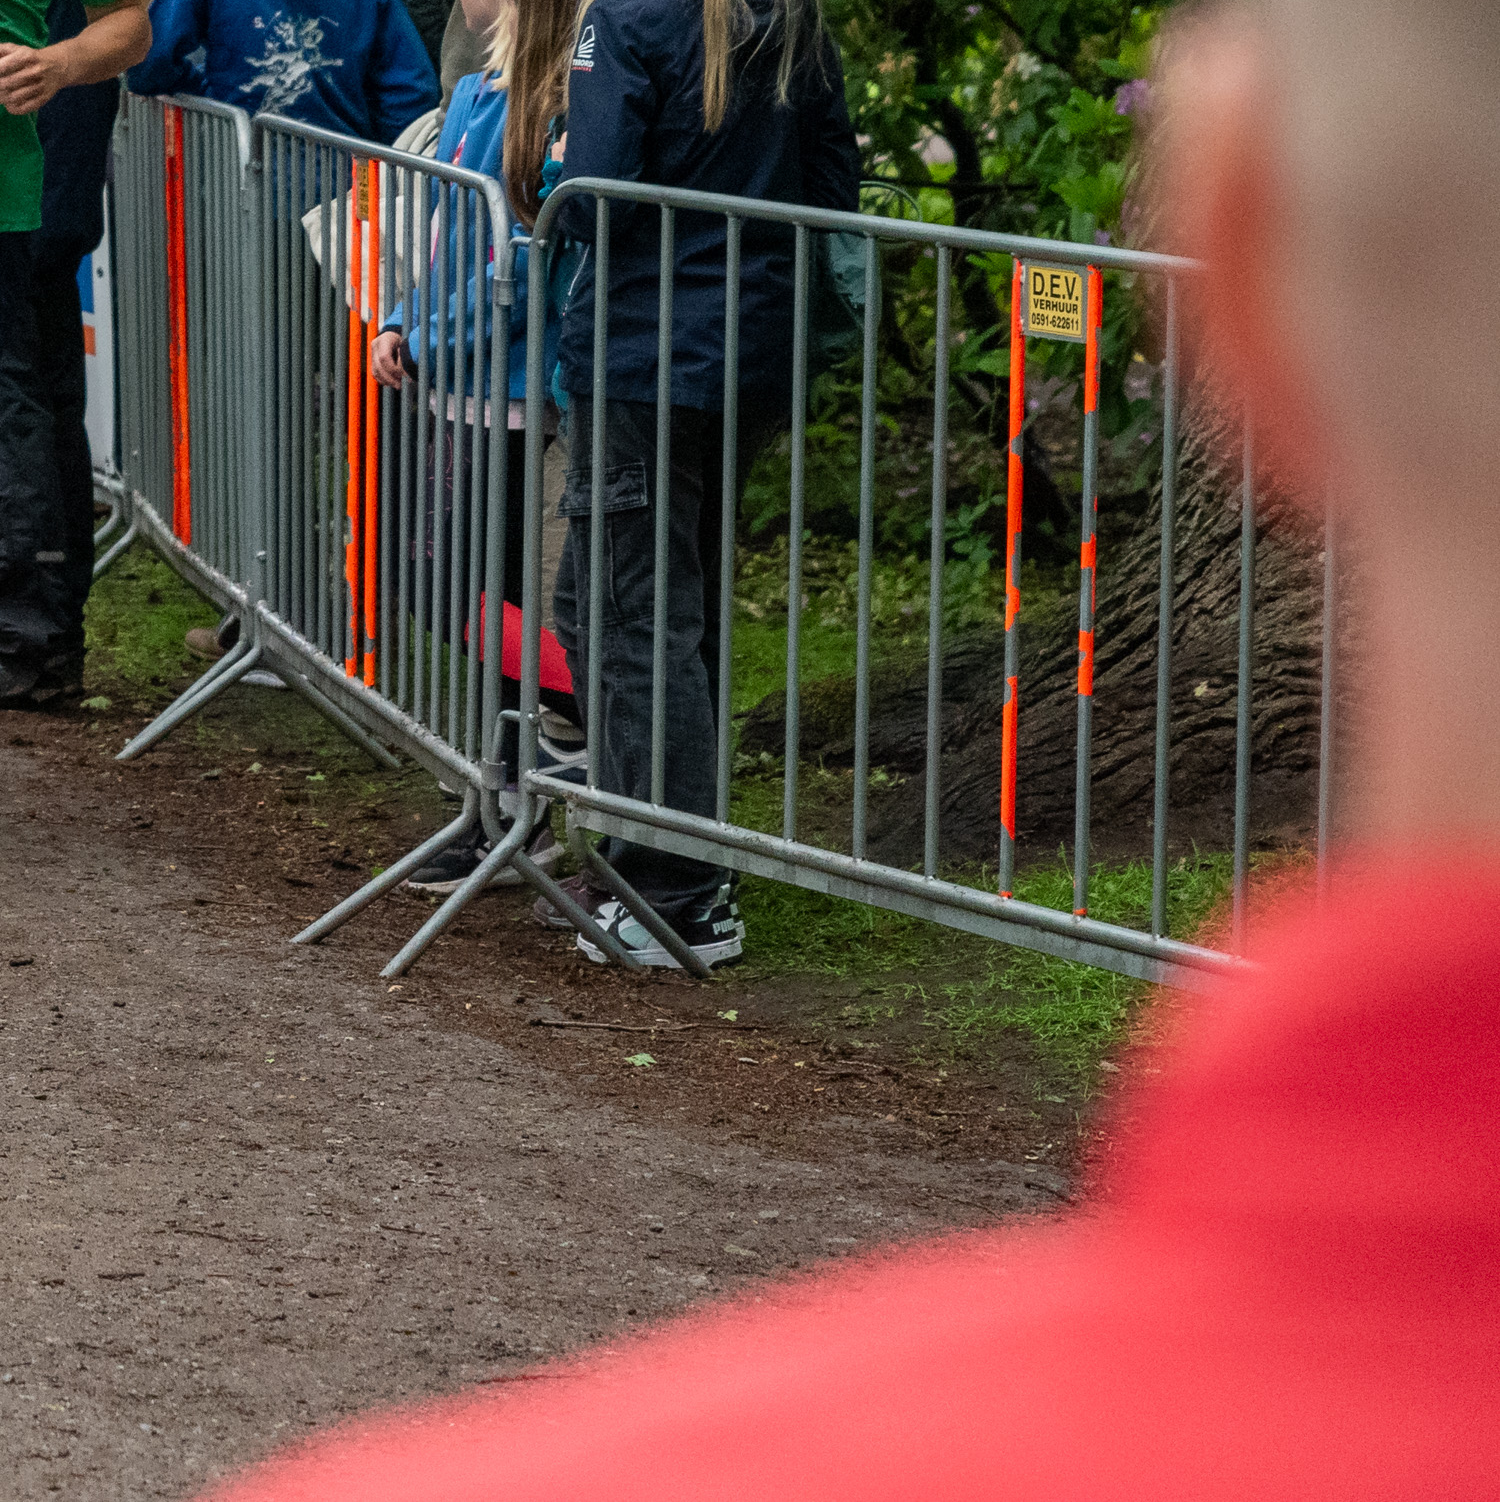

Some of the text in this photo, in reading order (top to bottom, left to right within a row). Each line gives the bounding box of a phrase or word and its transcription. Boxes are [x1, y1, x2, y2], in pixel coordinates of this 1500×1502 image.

[1033, 272, 1079, 301] D.E.V.
[1033, 298, 1078, 315] VERHUUR
[1031, 312, 1079, 331] 0591-622611
